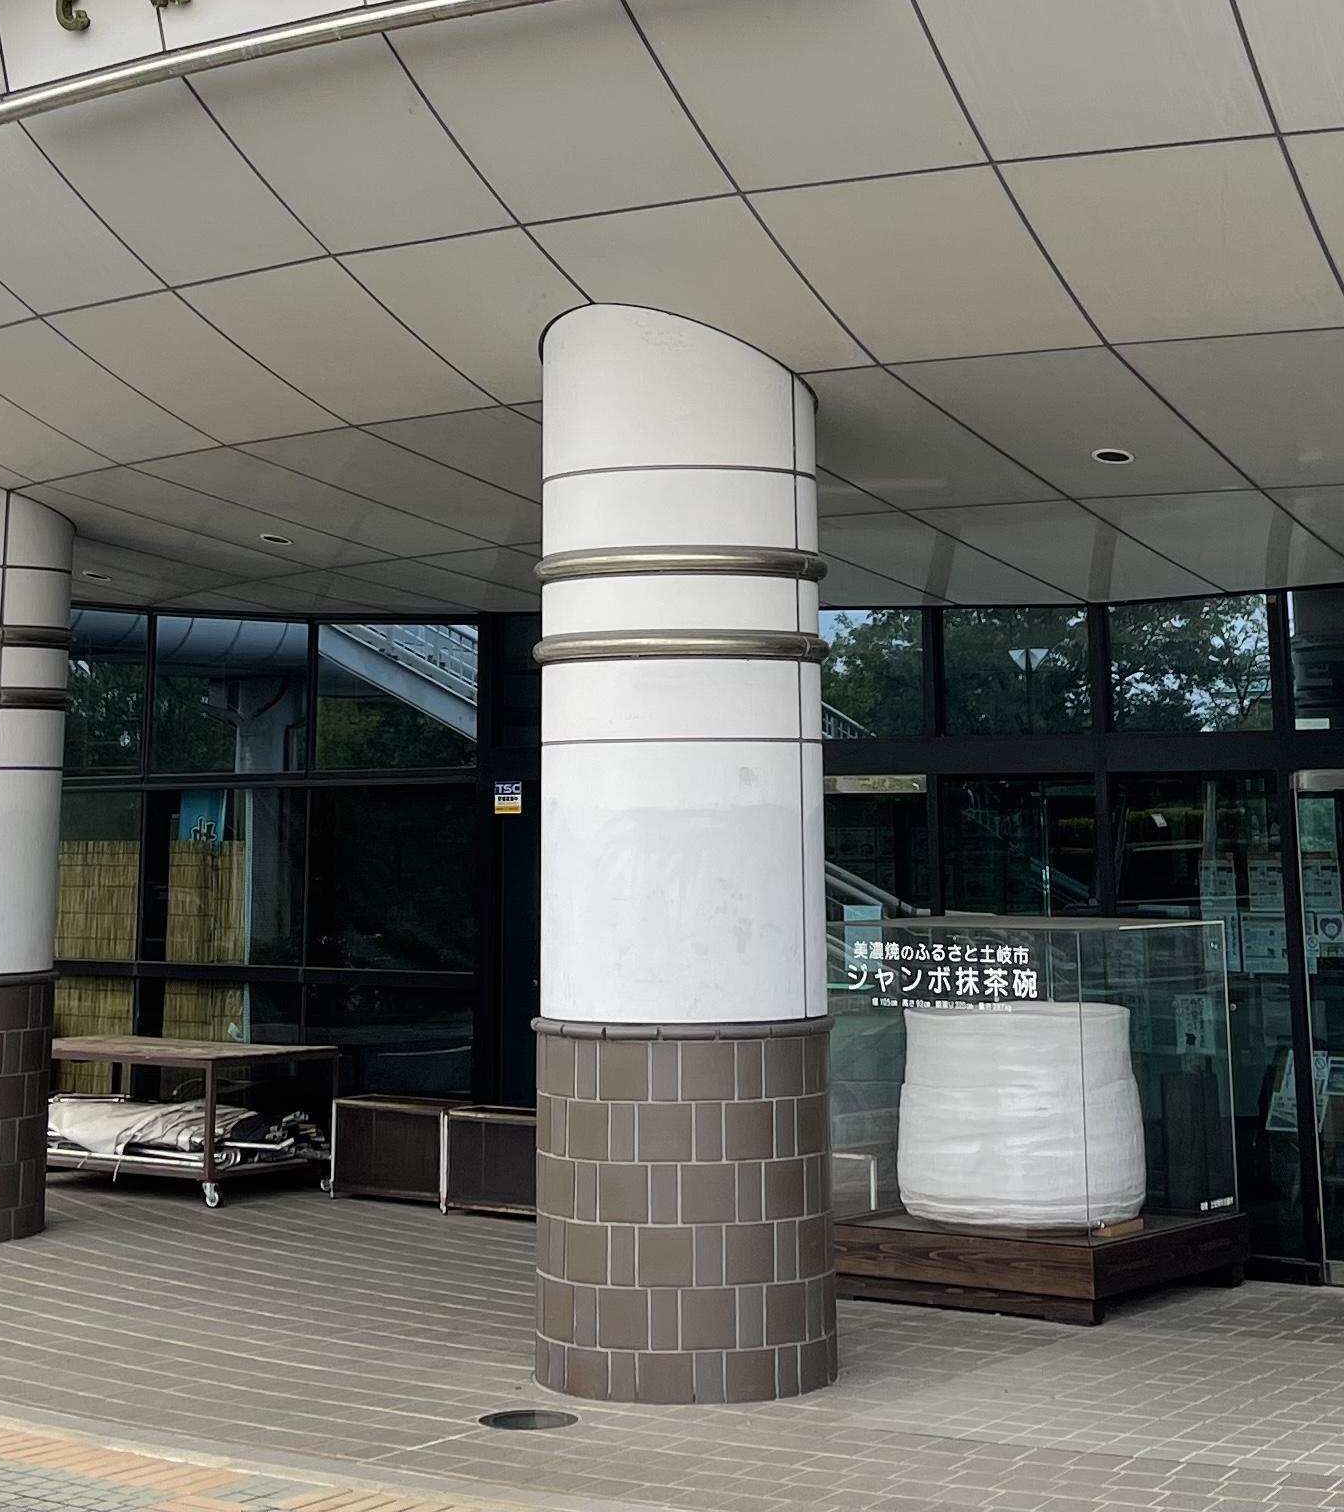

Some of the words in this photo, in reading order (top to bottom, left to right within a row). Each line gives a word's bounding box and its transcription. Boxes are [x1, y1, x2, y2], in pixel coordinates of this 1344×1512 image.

[496, 784, 521, 794] TSC
[853, 941, 1030, 965] 美濃焼のふるさと土岐市
[847, 964, 1038, 999] ジャンボ抹茶碗
